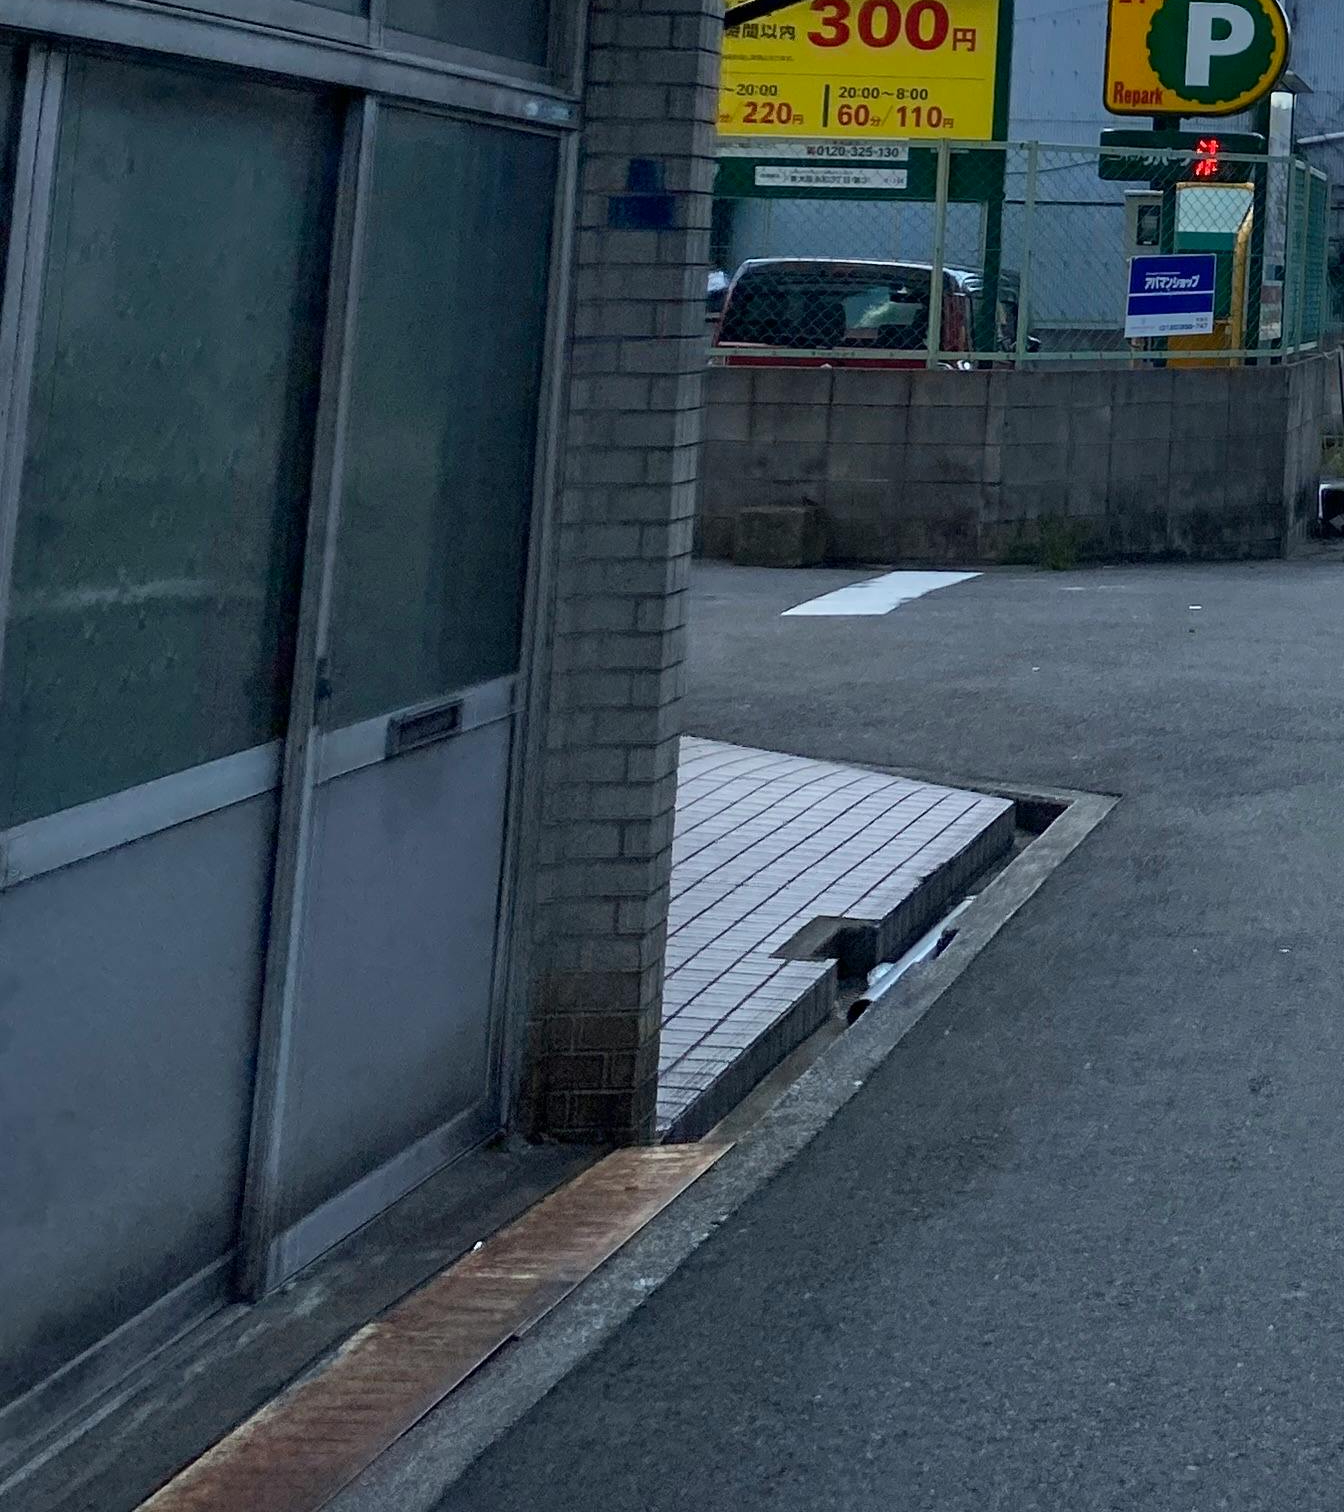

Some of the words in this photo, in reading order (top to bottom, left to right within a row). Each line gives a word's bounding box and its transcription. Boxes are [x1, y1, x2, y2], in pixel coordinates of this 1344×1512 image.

[1185, 1, 1255, 86] P
[1113, 81, 1163, 107] Repark
[1144, 274, 1200, 291] アパマンショップ
